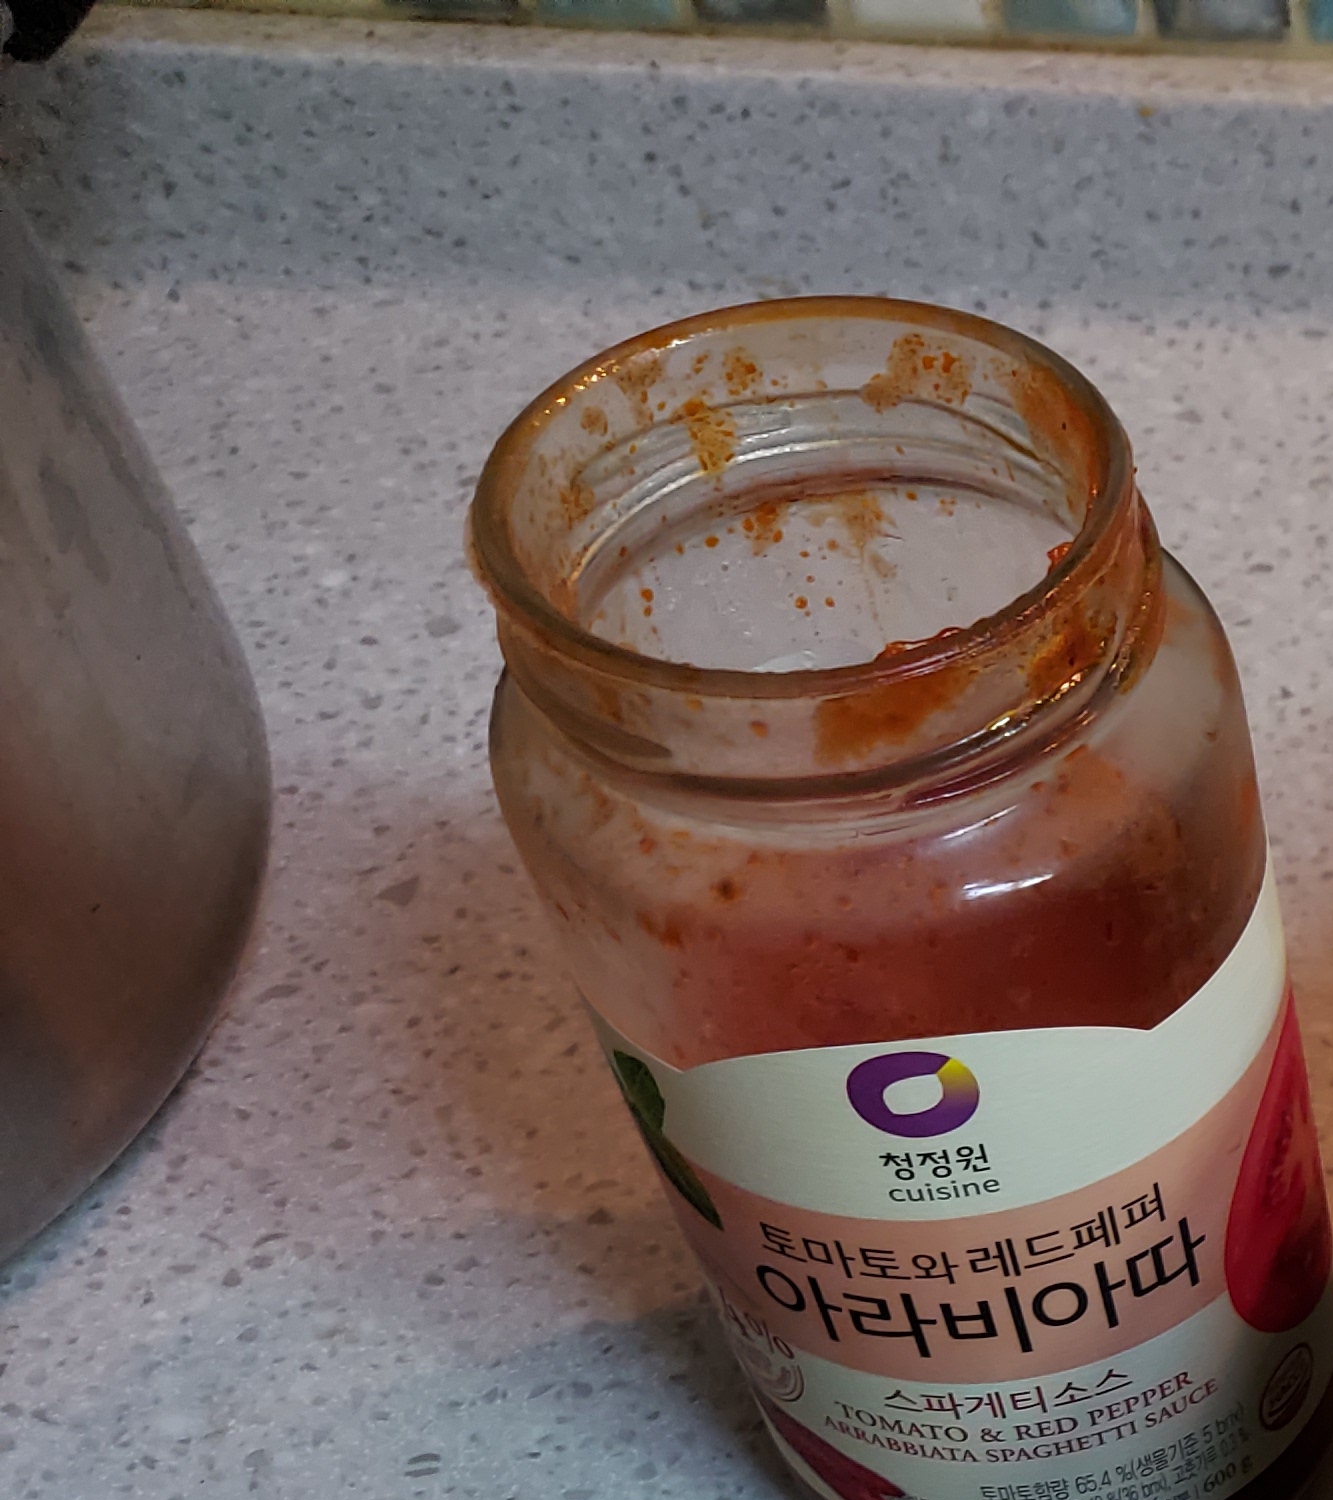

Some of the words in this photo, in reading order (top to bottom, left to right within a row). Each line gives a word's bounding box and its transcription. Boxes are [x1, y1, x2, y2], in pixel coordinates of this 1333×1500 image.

[879, 1143, 991, 1181] 청정원
[889, 1177, 1001, 1203] cuisine
[756, 1217, 1207, 1358] 아라비아따
[824, 1415, 980, 1463] ARRABBIATA
[985, 1420, 1138, 1463] SPAGHETTI
[1144, 1377, 1219, 1428] SAUCE
[834, 1401, 969, 1443] TOMATO
[979, 1427, 1007, 1443] &
[1013, 1416, 1079, 1441] RED
[1087, 1371, 1193, 1427] PEPPER
[1075, 1469, 1112, 1495] 65.4
[1202, 1462, 1237, 1493] 600
